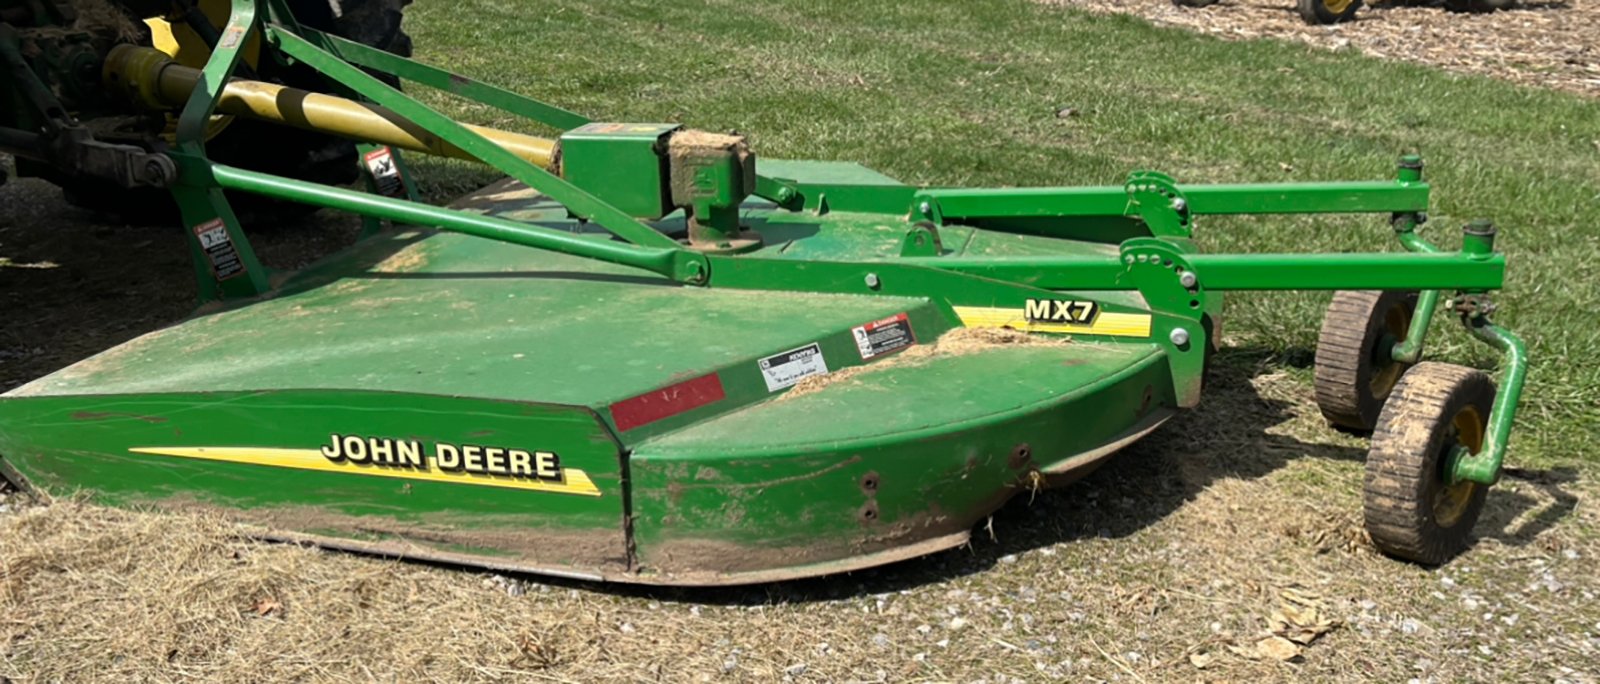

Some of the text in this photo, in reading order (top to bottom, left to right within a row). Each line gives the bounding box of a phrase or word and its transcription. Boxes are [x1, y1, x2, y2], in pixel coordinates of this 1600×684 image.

[1025, 299, 1095, 322] MX7
[321, 434, 559, 478] JOHN DEERE
